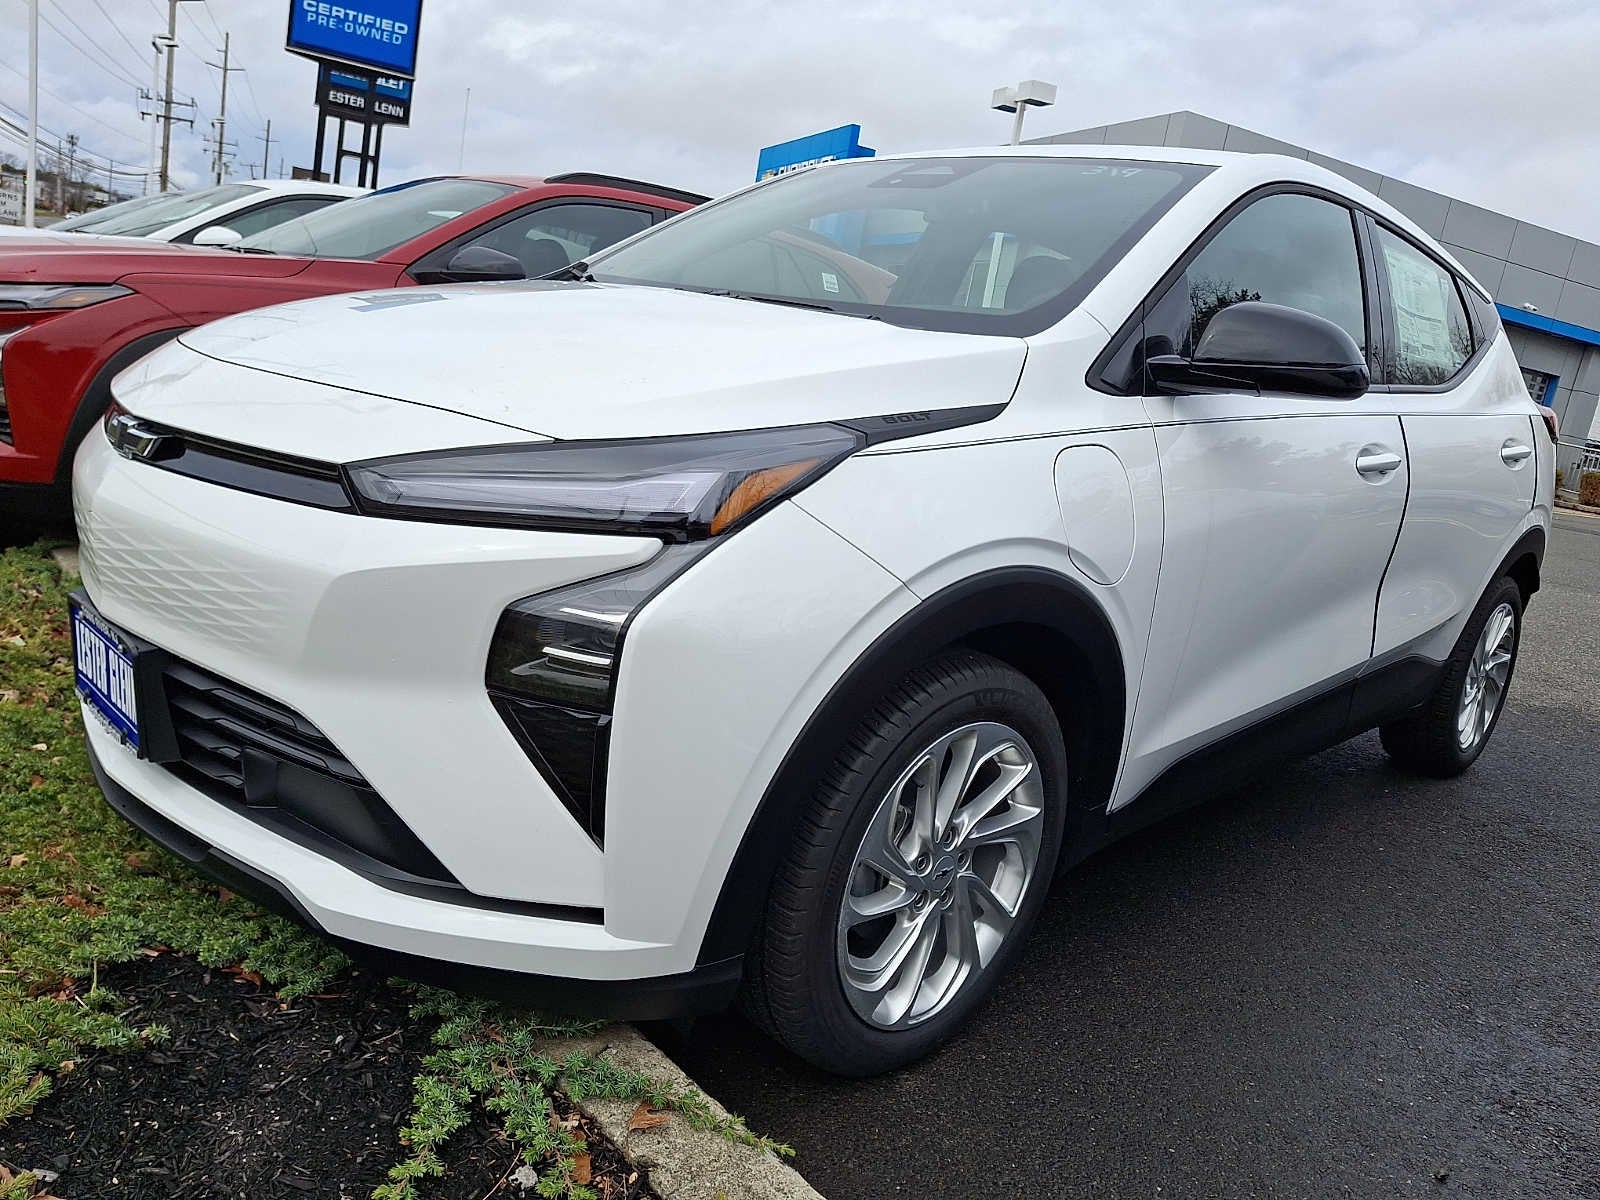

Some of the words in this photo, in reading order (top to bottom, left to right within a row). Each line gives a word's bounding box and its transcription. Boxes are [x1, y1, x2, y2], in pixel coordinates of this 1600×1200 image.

[303, 0, 408, 34] CERTIFIED
[307, 12, 402, 45] PRE-OWNED
[328, 90, 365, 108] ESTER
[374, 101, 404, 118] LENN
[881, 412, 930, 424] BOLT
[75, 619, 108, 696] LESTER
[108, 649, 138, 726] GLENN
